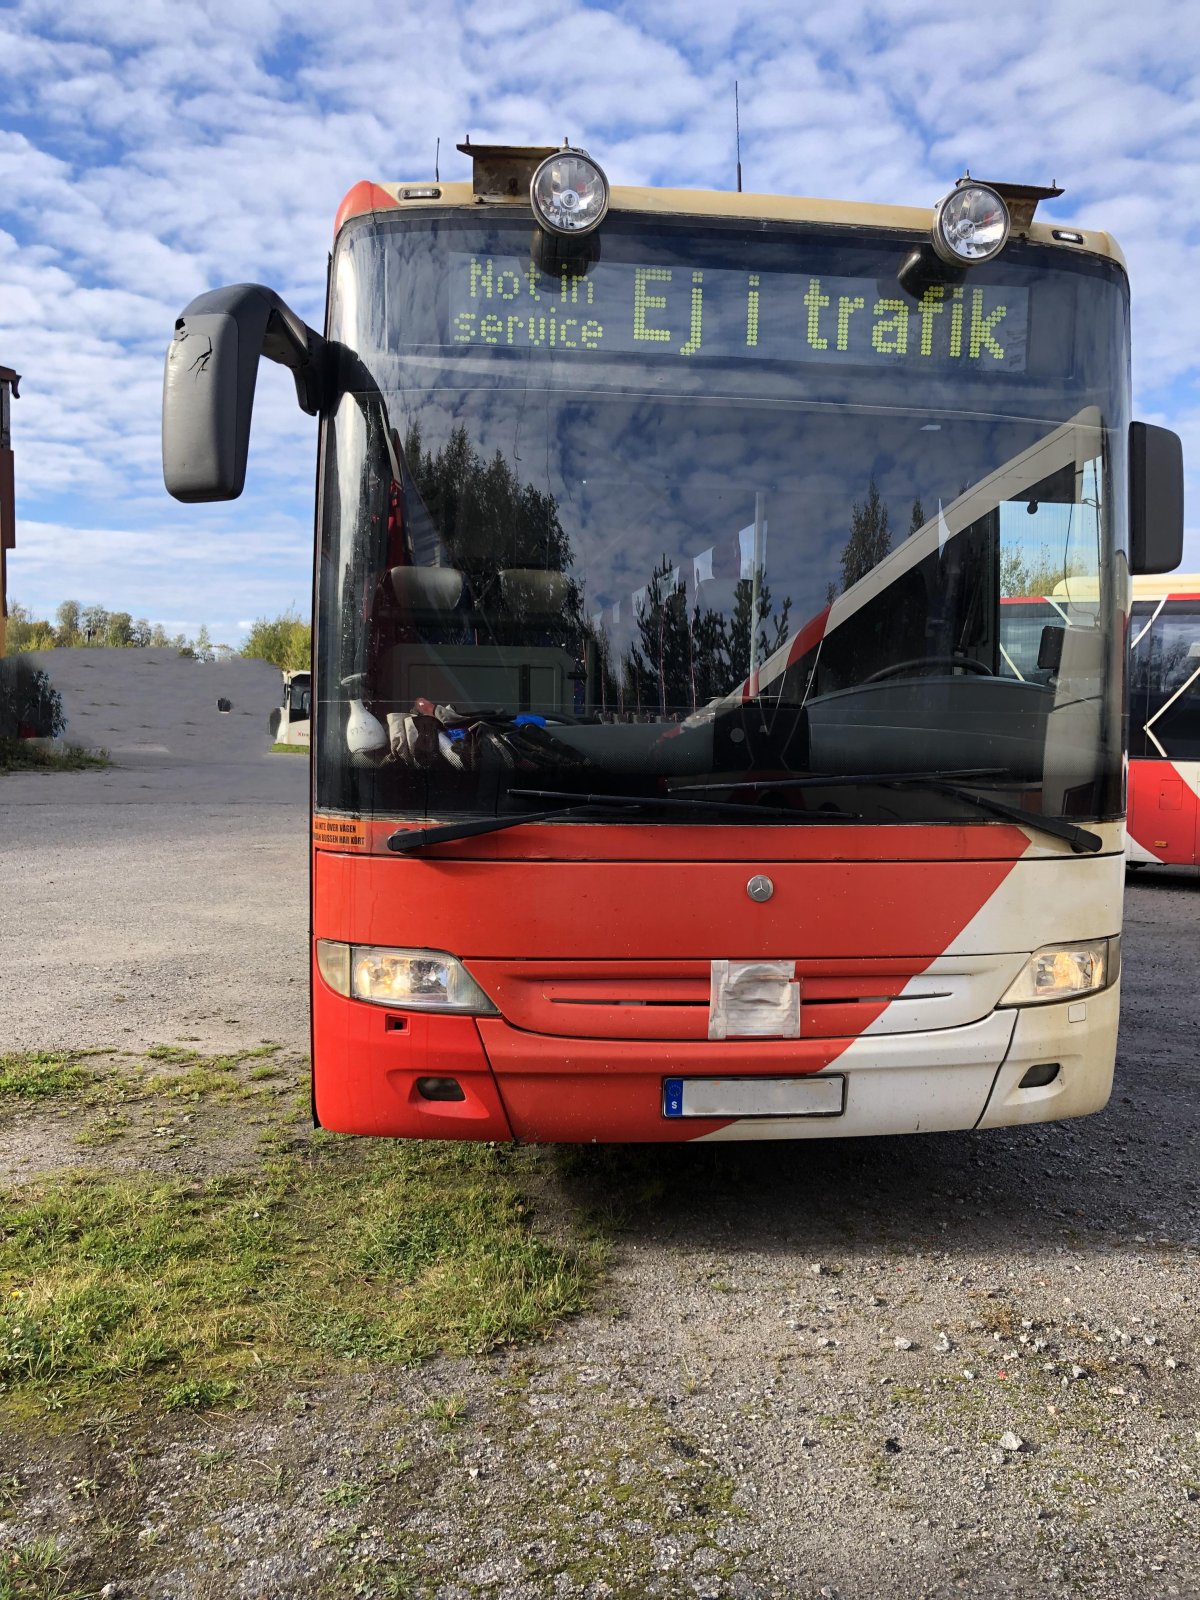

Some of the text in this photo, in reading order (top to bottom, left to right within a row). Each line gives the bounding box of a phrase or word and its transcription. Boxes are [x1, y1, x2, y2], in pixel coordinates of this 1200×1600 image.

[470, 257, 594, 304] Not in
[453, 307, 604, 348] service
[632, 267, 1007, 360] Ej i trafik
[671, 1100, 678, 1110] S
